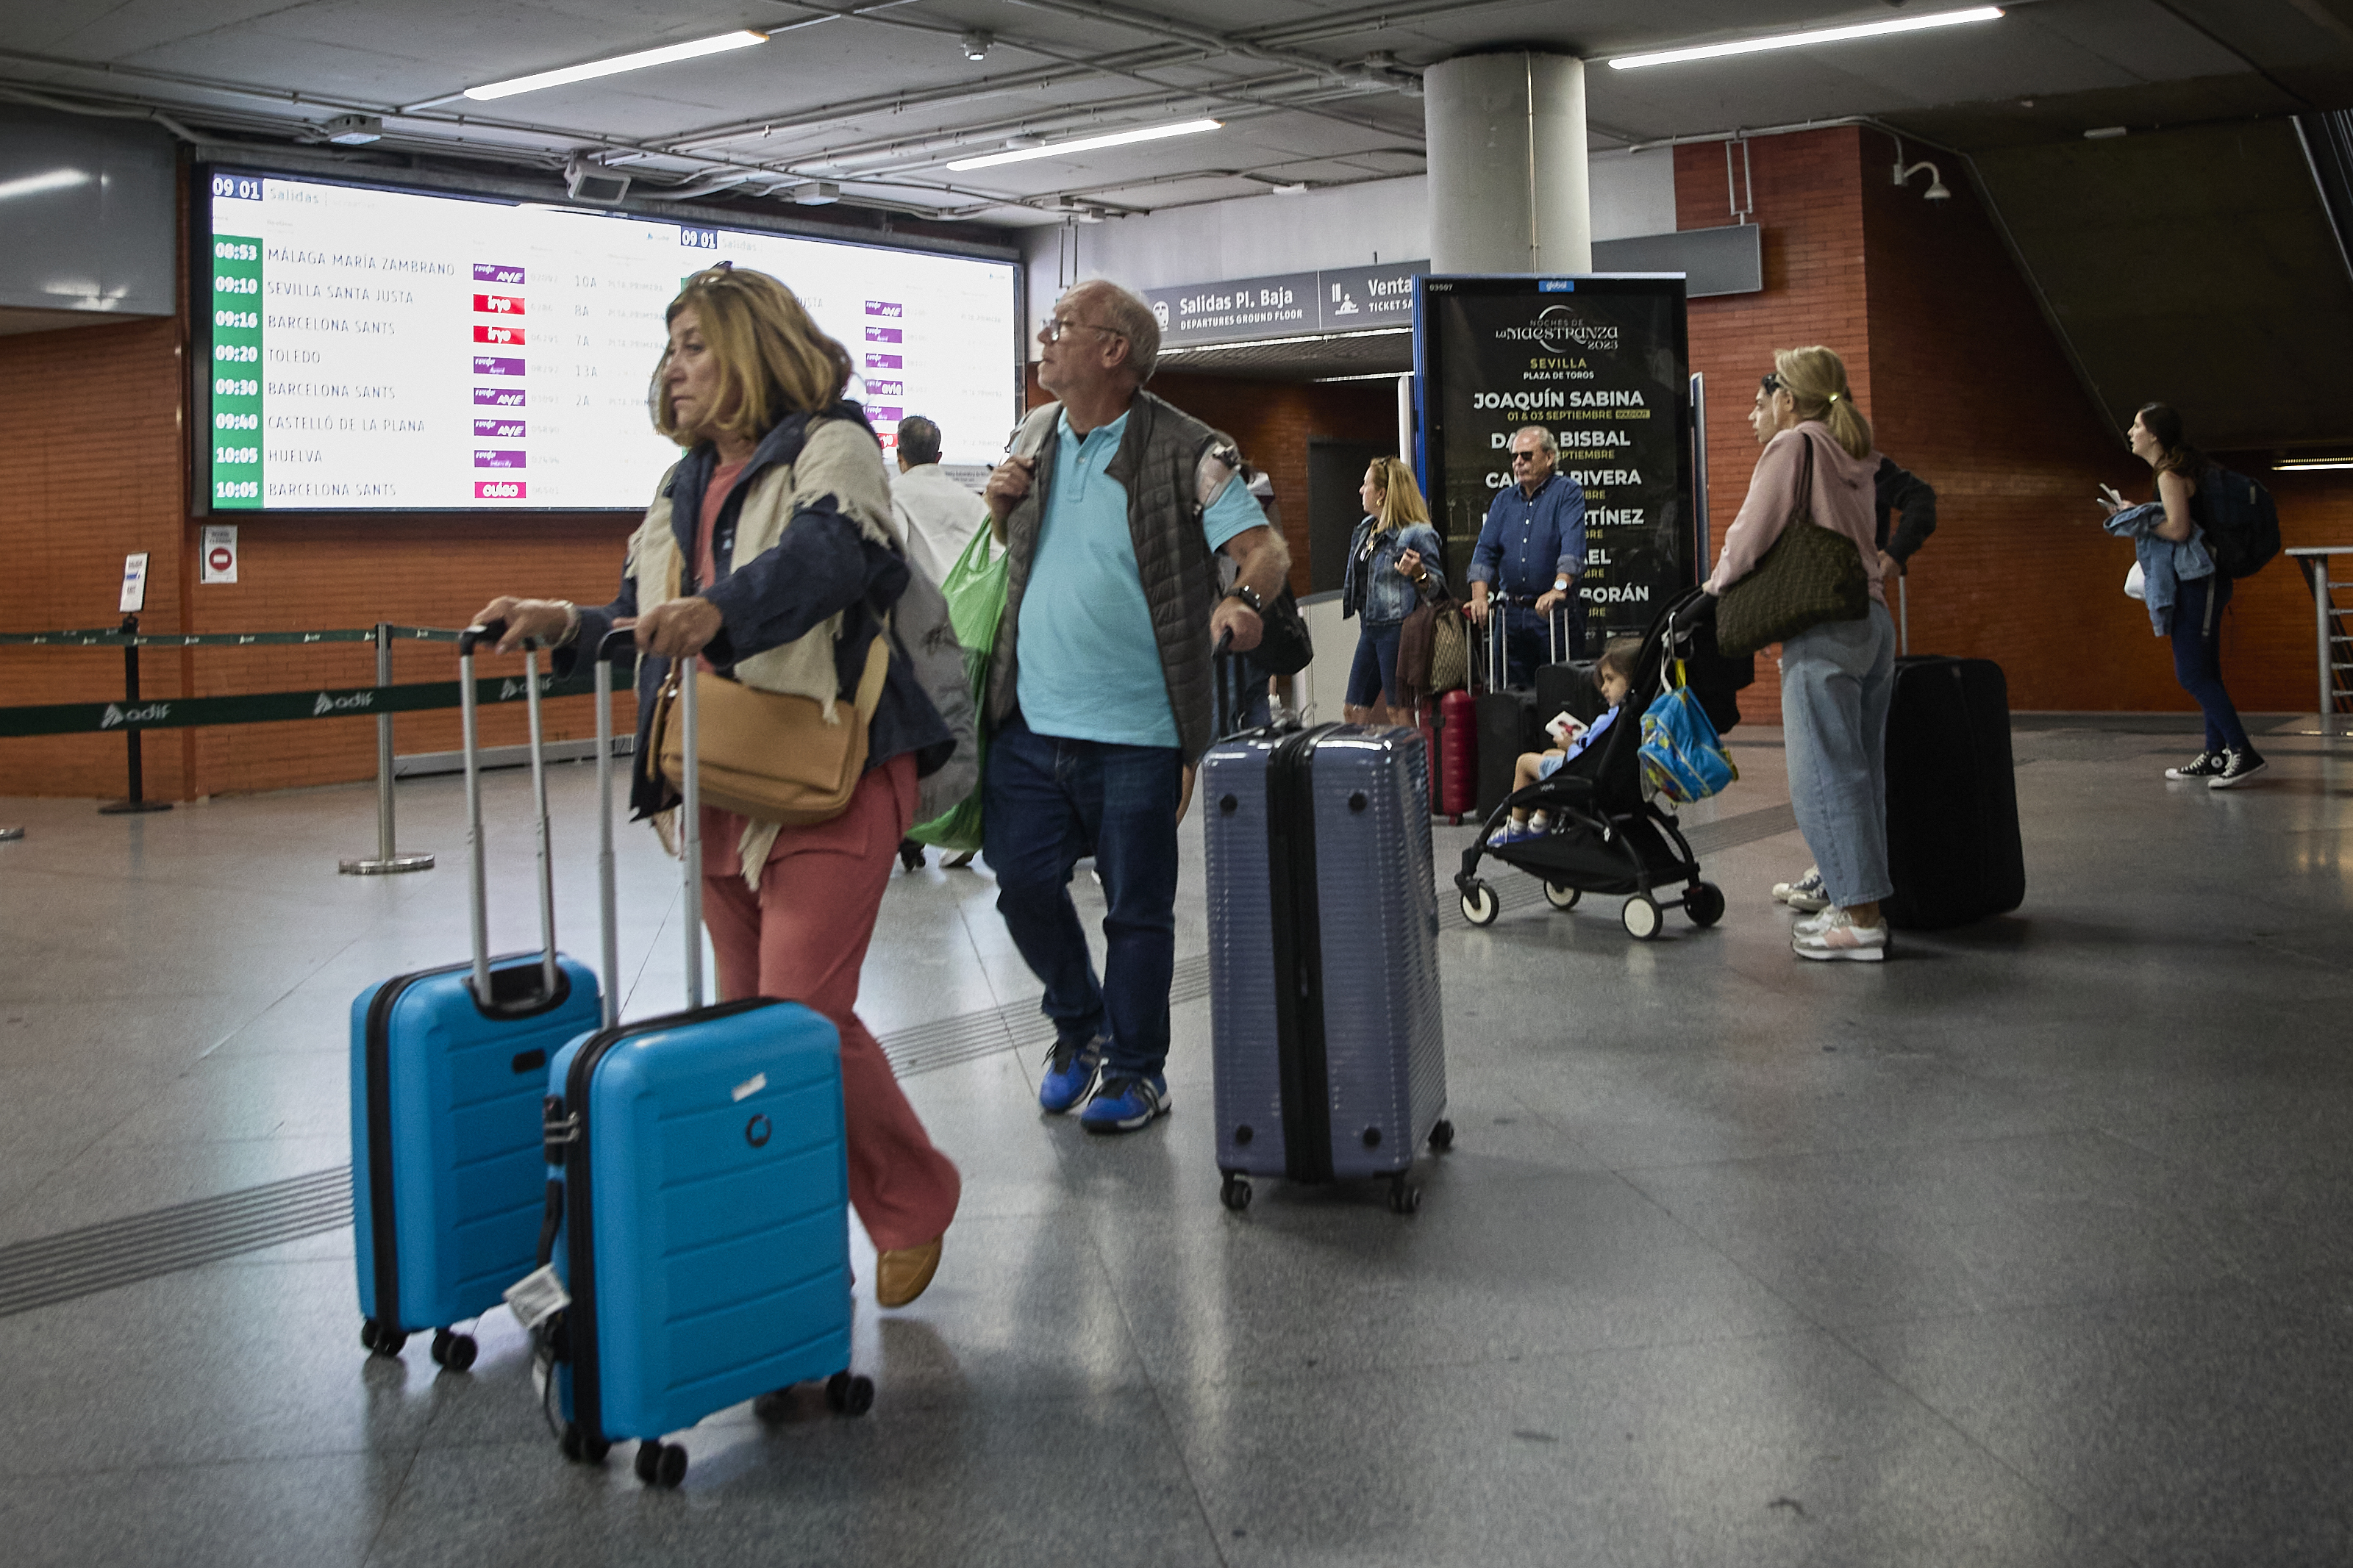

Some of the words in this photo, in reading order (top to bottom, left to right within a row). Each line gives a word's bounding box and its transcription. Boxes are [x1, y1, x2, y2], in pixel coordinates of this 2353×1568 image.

[213, 177, 234, 196] 09
[239, 180, 260, 199] 01
[270, 187, 319, 204] Salidas
[682, 230, 697, 246] 09
[701, 232, 715, 248] 01
[268, 246, 326, 265] MÁLAGA
[333, 254, 376, 269] MARÍA
[382, 258, 454, 276] ZAMBRANO
[215, 276, 257, 294] 09:10
[268, 281, 321, 297] SEVILLA
[327, 285, 370, 301] SANTA
[376, 289, 413, 304] JUSTA
[1180, 294, 1232, 315] Salidas
[1236, 291, 1254, 309] Pl.
[1260, 287, 1293, 308] Baja
[1369, 298, 1401, 312] TICKET
[268, 315, 349, 332] BARCELONA
[355, 321, 395, 335] SANTS
[1180, 315, 1235, 331] DEPARTURES
[1236, 311, 1272, 325] GROUND
[1275, 308, 1302, 322] FLOOR
[1530, 318, 1568, 327] NOCHES
[1571, 318, 1584, 327] DE
[215, 345, 257, 362] 09:20
[1588, 340, 1618, 350] 2023
[268, 348, 321, 364] TOLEDO
[1530, 357, 1587, 369] SEVILLA
[1524, 370, 1551, 380] PLAZA
[1552, 370, 1564, 380] DE
[1565, 370, 1595, 380] TOROS
[268, 382, 349, 398] BARCELONA
[355, 386, 396, 399] SANTS
[1474, 387, 1564, 411] JOAQUÍN
[1569, 390, 1644, 407] SABINA
[215, 413, 257, 430] 09:40
[268, 415, 333, 430] CASTELLÓ
[340, 418, 355, 431] DE
[363, 418, 377, 432] LA
[384, 419, 425, 432] PLANA
[1507, 411, 1518, 421] 01
[1521, 411, 1528, 421] &
[1530, 411, 1543, 421] 03
[1546, 409, 1613, 421] SEPTIEMBRE
[1560, 430, 1631, 448] BISBAL
[268, 449, 322, 462] HUELVA
[1571, 469, 1642, 486] RIVERA
[268, 483, 349, 496] BARCELONA
[355, 483, 396, 497] SANTS
[126, 704, 171, 721] adif
[335, 691, 374, 709] adif
